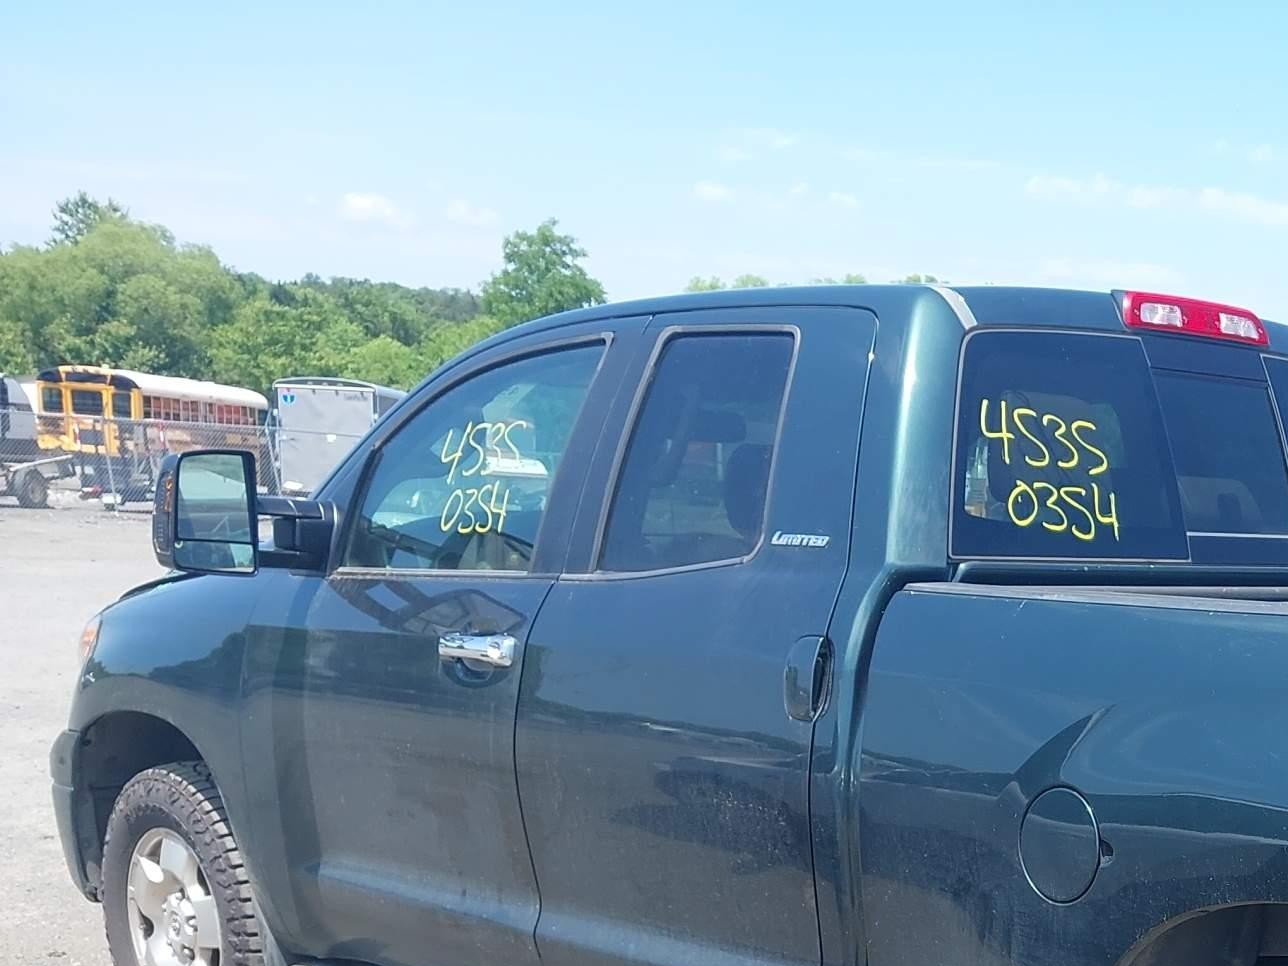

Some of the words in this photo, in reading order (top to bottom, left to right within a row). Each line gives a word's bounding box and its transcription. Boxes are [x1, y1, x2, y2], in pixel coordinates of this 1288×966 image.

[441, 420, 527, 484] 4535
[980, 399, 1108, 475] 4535
[440, 480, 510, 534] 0354
[1007, 480, 1120, 541] 0354
